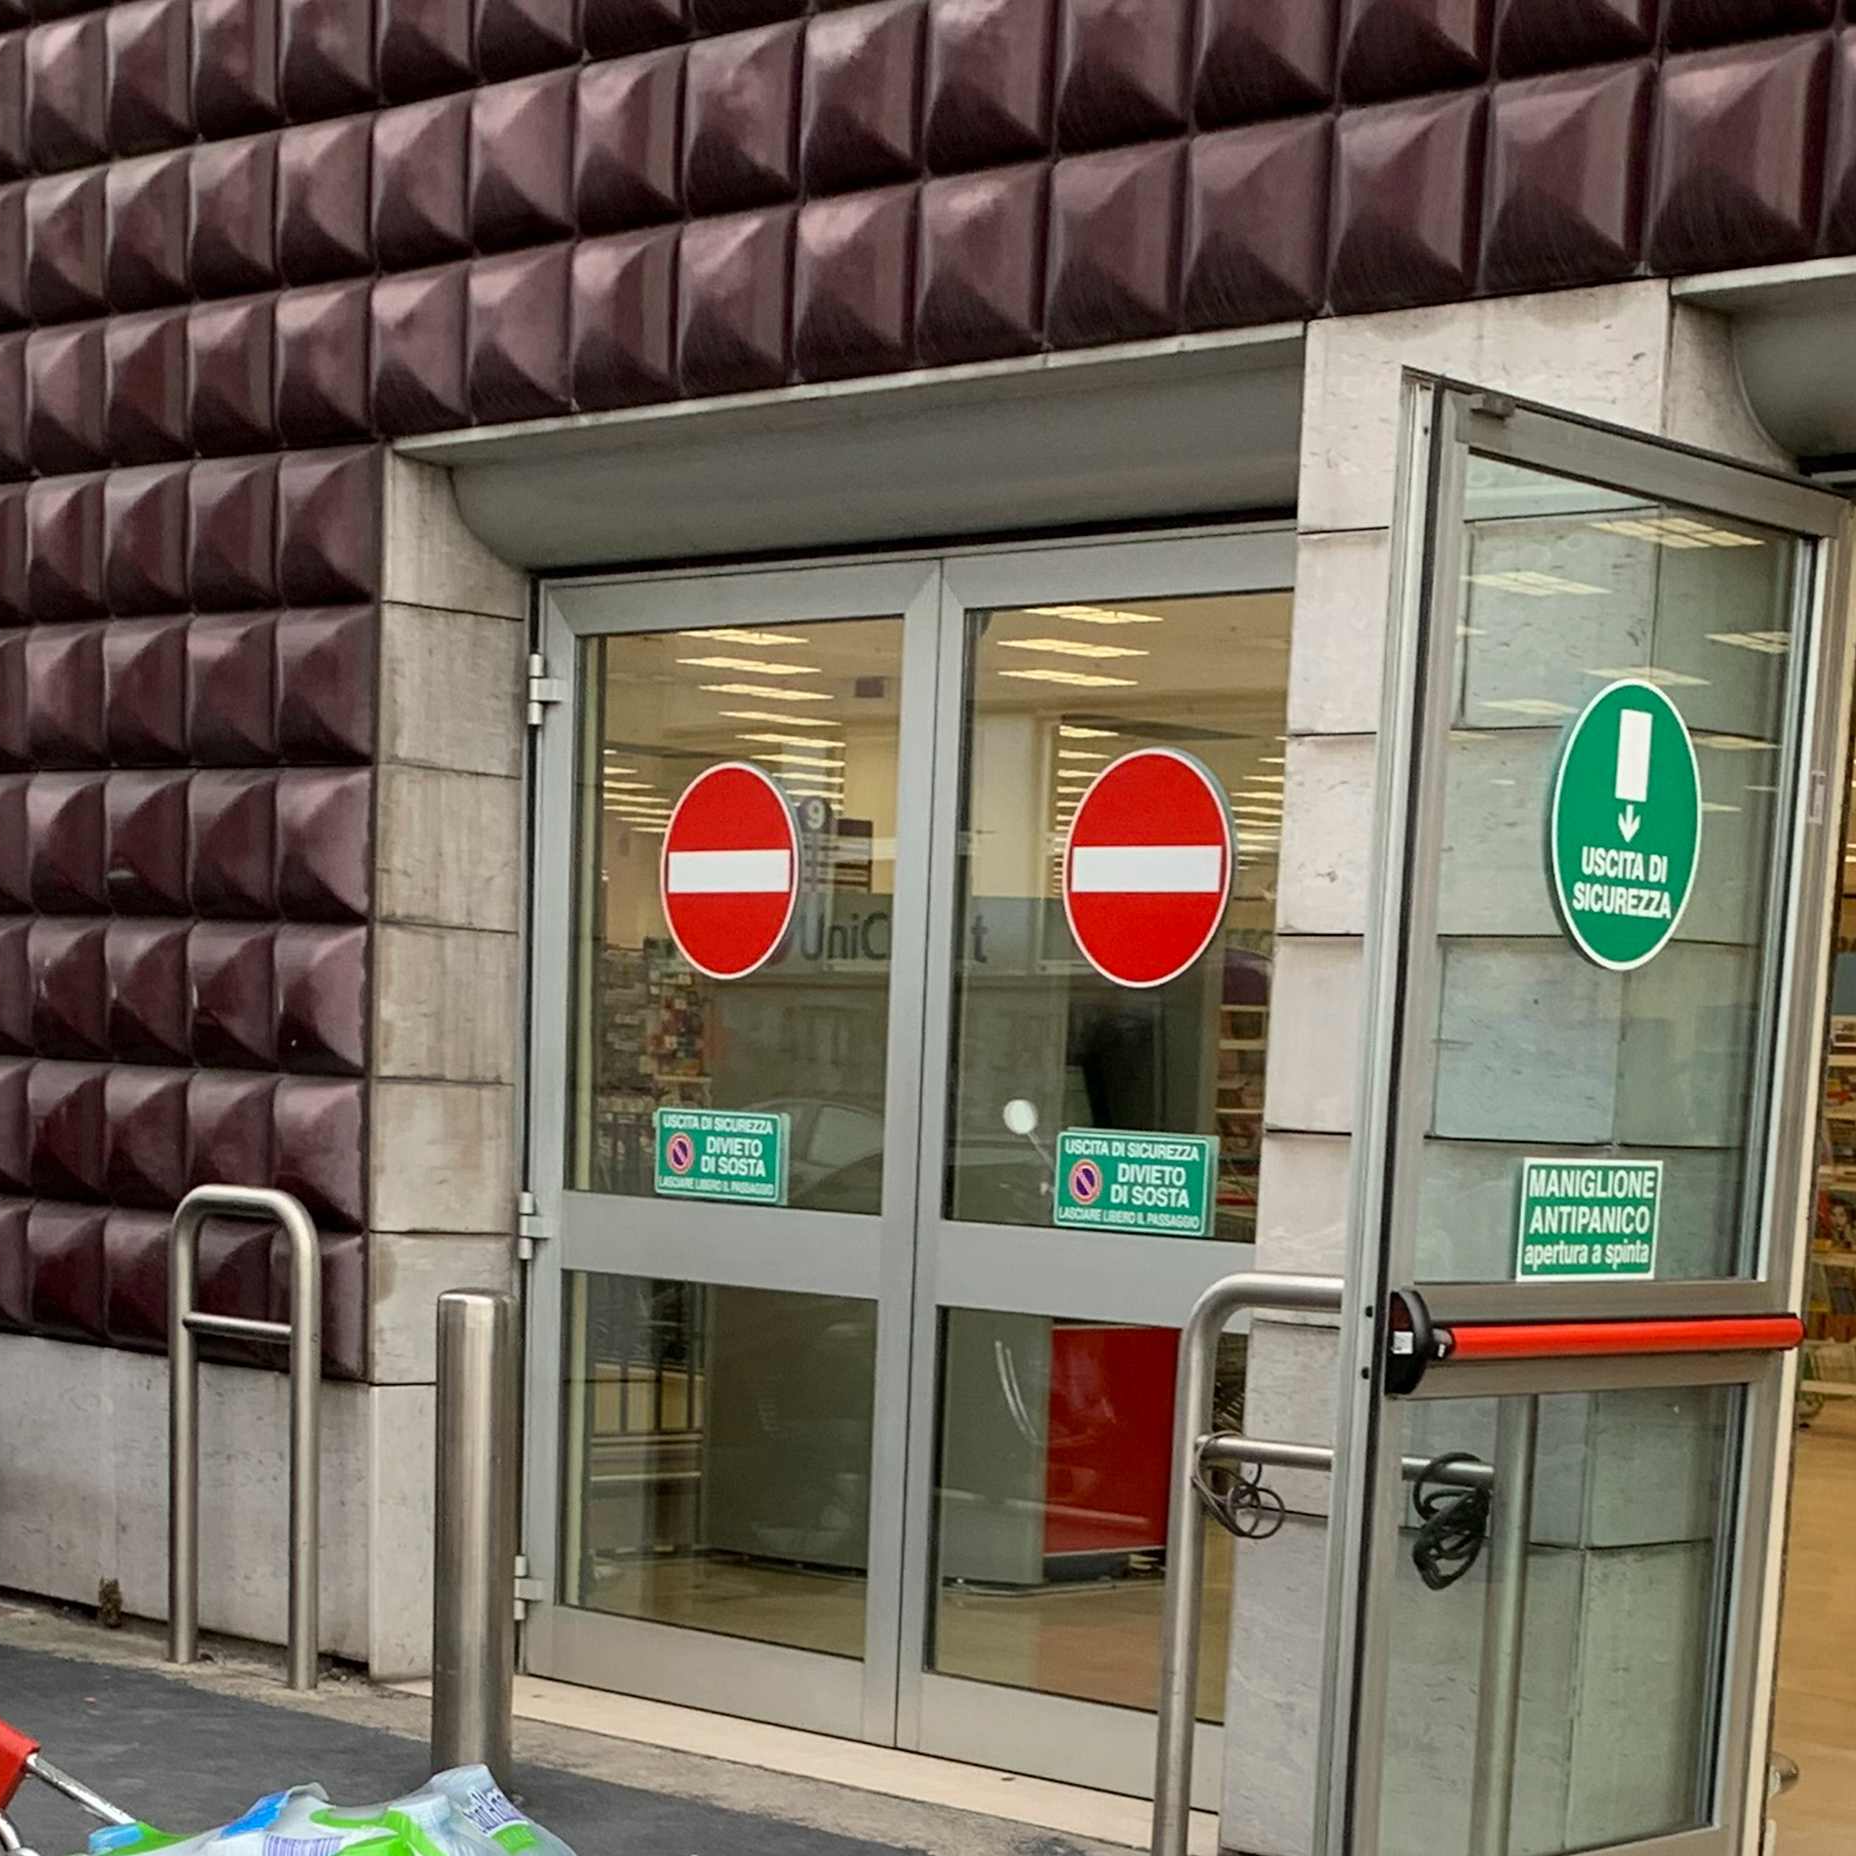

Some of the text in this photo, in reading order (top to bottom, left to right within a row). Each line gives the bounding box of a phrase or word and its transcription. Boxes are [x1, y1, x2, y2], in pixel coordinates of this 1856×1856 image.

[807, 798, 826, 829] 9
[1582, 846, 1667, 883] USCITA DI
[1573, 881, 1672, 920] SICUREZZA
[663, 1114, 773, 1134] USCITA DI SICUREZZA
[706, 1136, 762, 1157] DIVIETO
[1065, 1138, 1200, 1161] USCITA DI SICUREZZA
[701, 1155, 766, 1177] DI SOSTA
[1117, 1163, 1186, 1186] DIVIETO
[1110, 1184, 1190, 1208] DI SOSTA
[1528, 1167, 1656, 1199] MANIGLIONE
[1529, 1204, 1651, 1235] ANTIPANICO
[1524, 1239, 1649, 1273] apertura a spinta
